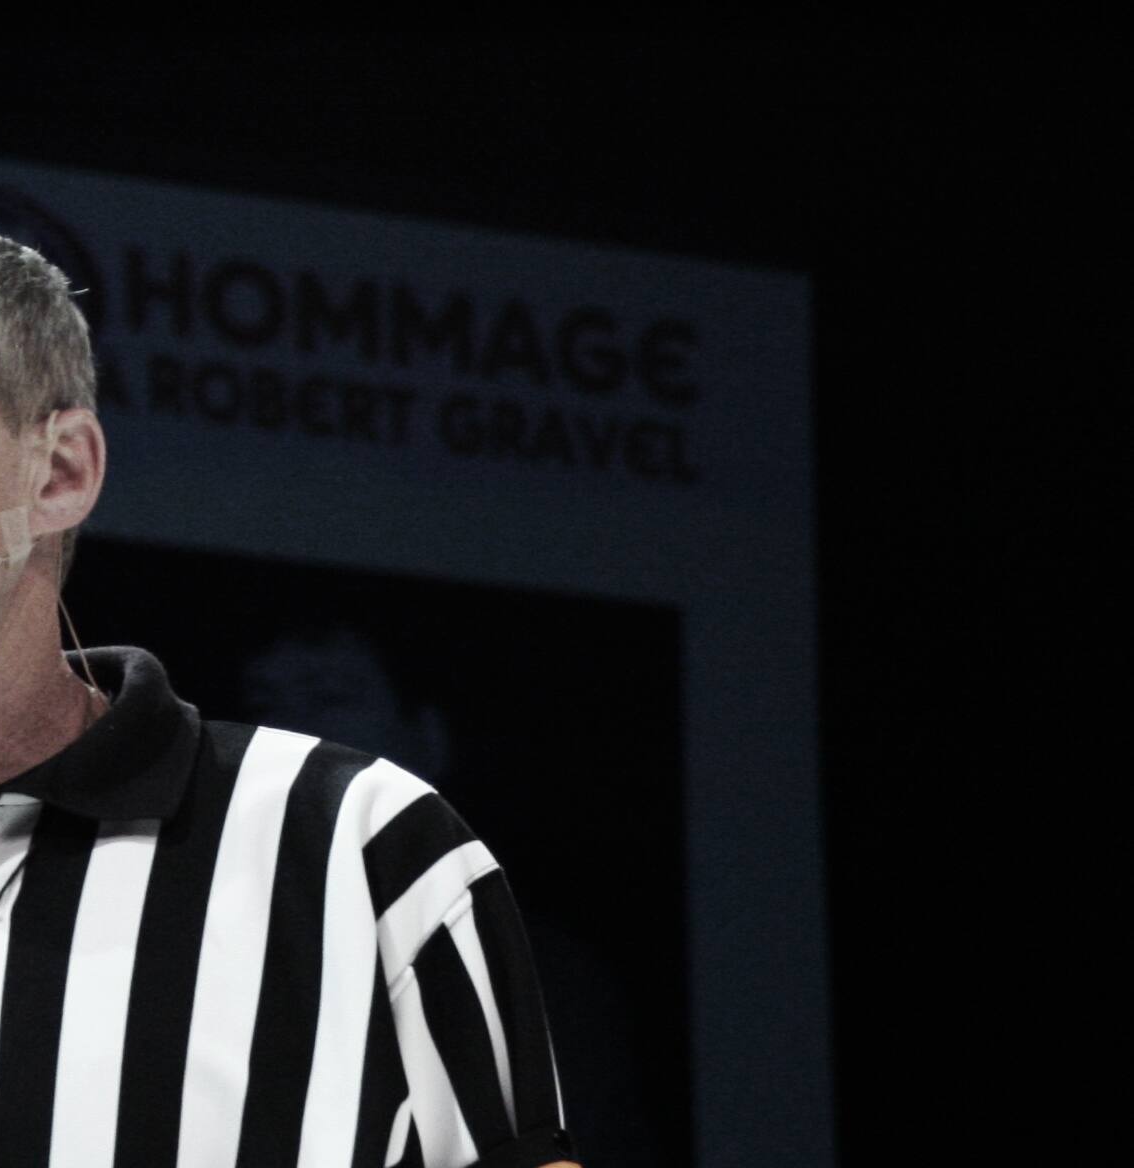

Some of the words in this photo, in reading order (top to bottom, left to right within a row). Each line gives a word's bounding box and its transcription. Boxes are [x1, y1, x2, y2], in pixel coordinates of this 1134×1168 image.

[125, 245, 696, 408] HOMMAGE
[147, 354, 417, 444] ROBERT
[438, 394, 698, 483] GRAVEL
